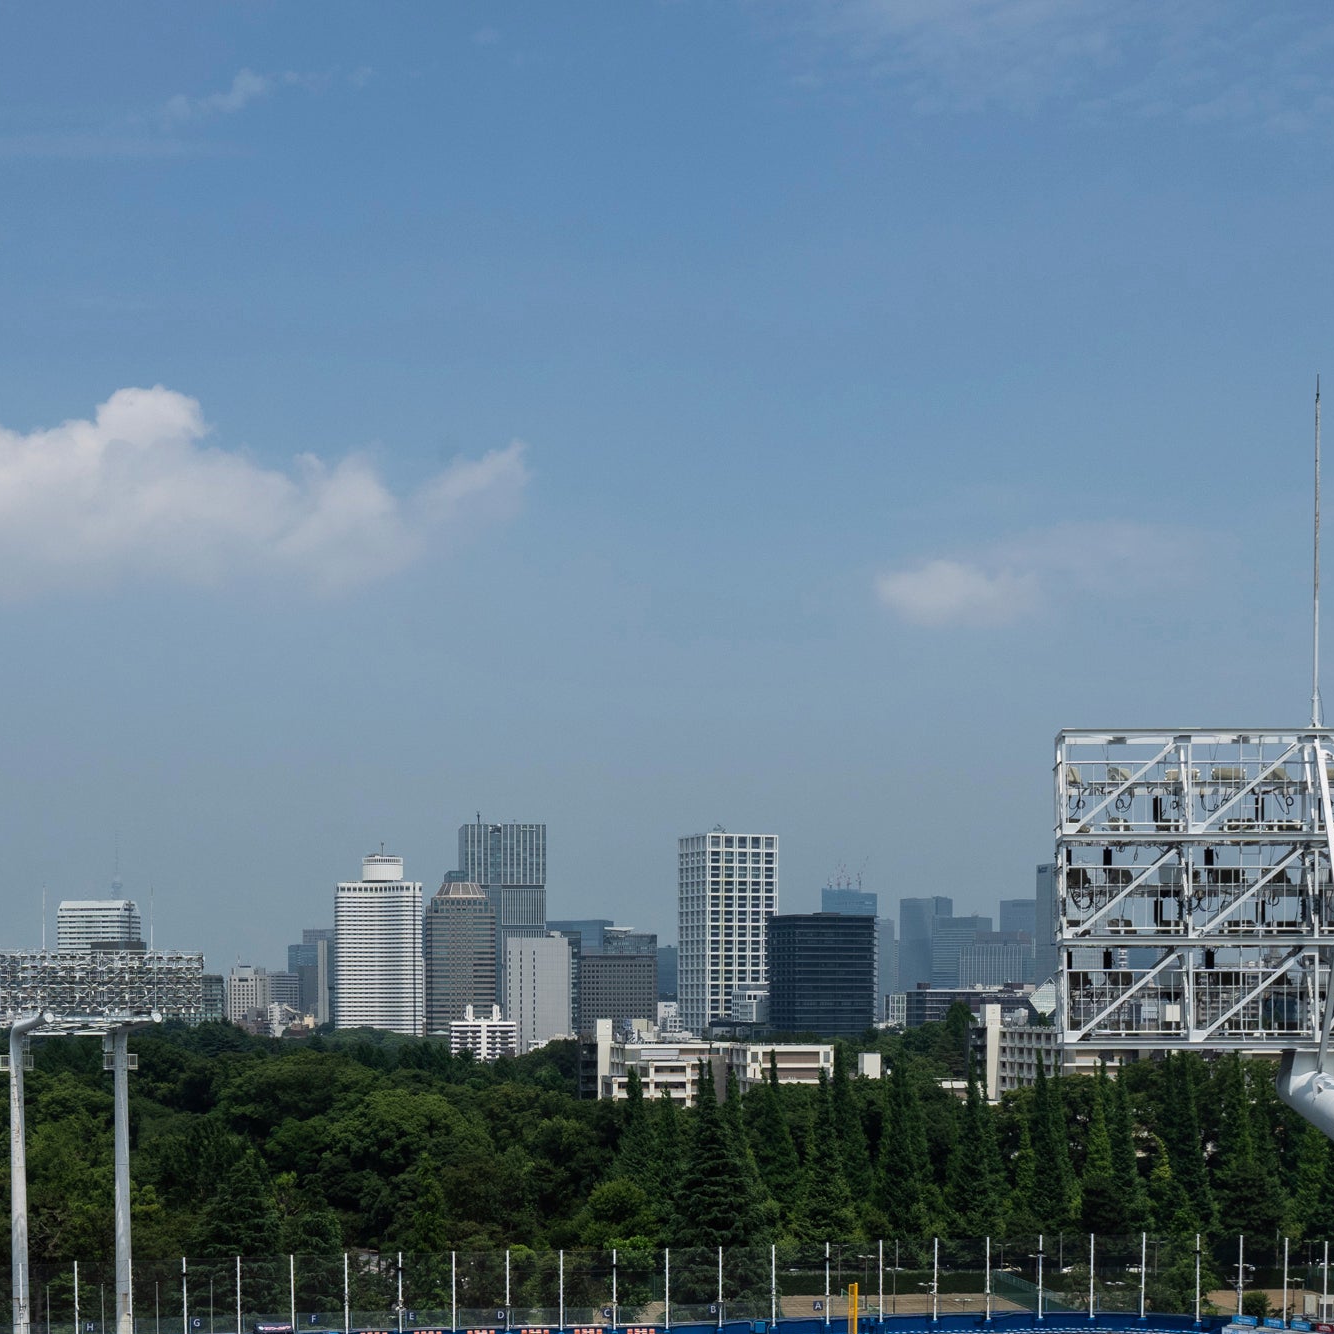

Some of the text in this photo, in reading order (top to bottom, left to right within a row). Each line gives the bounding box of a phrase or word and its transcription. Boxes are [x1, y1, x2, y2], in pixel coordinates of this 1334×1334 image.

[710, 1305, 717, 1314] B
[814, 1302, 822, 1310] A
[409, 1312, 415, 1320] E
[497, 1311, 504, 1319] D
[604, 1308, 611, 1317] C
[194, 1318, 201, 1327] G
[311, 1315, 317, 1323] F
[86, 1323, 94, 1332] H
